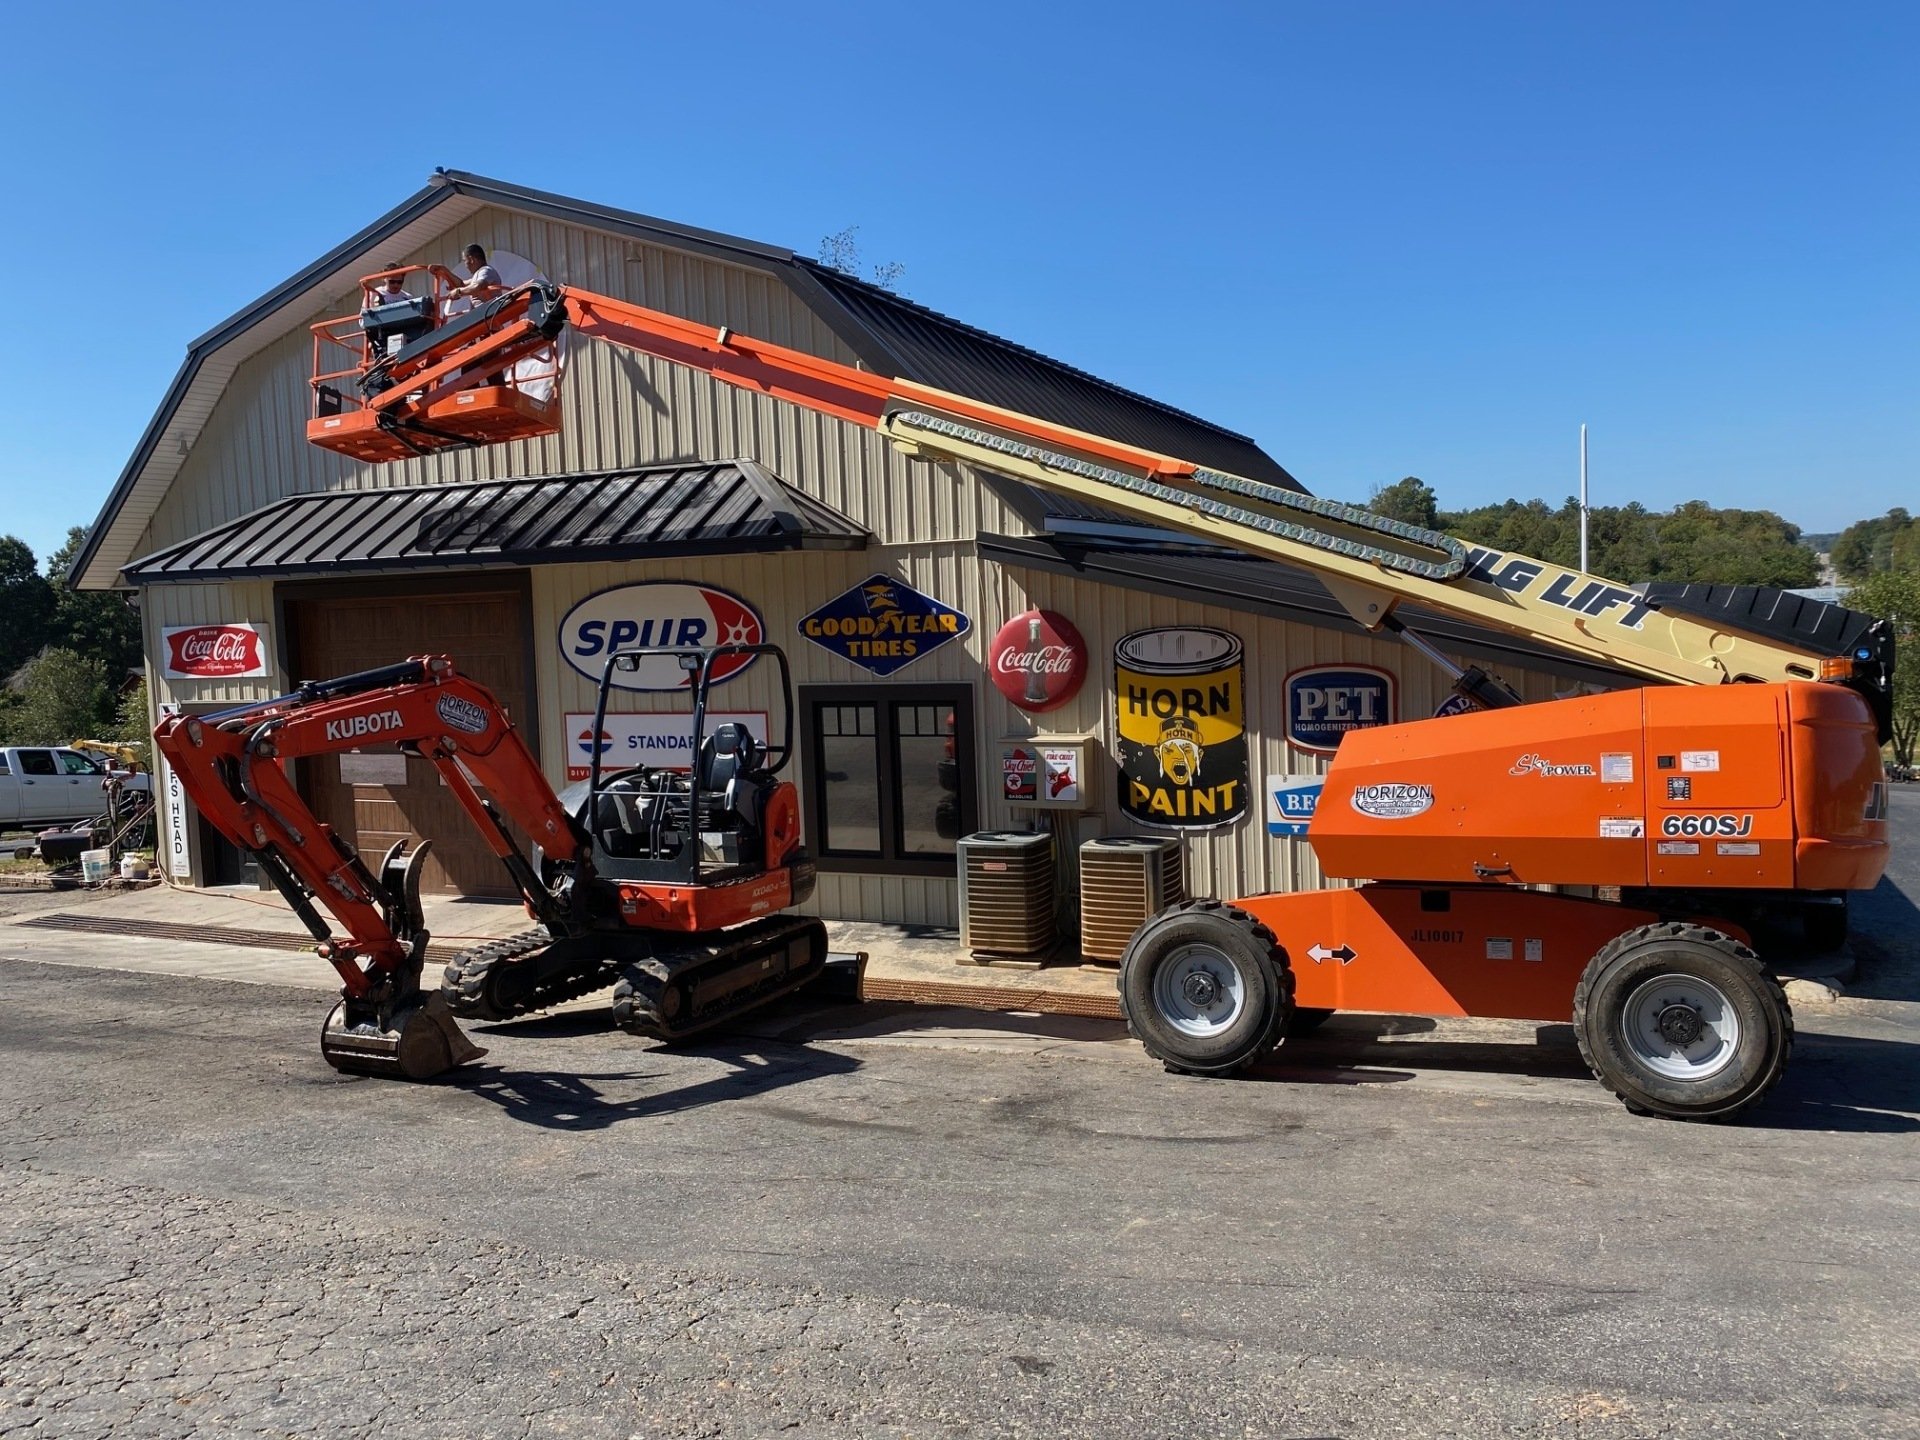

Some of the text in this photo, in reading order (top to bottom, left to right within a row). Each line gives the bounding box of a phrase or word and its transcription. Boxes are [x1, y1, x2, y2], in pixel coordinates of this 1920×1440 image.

[1538, 572, 1660, 628] LIFT
[182, 632, 247, 662] Coca-Cola
[574, 618, 708, 656] SPUR
[846, 639, 918, 657] TIRES
[997, 646, 1075, 673] Coca-Cola
[439, 691, 488, 722] HORIZON
[1128, 681, 1230, 719] HORN
[1297, 687, 1381, 721] PET
[326, 710, 404, 741] KUBOTA
[1166, 730, 1193, 741] HORN
[628, 735, 706, 749] STANDA
[1129, 779, 1238, 817] PAINT
[1355, 785, 1432, 801] HORIZON
[171, 803, 183, 854] HEAD
[1661, 814, 1753, 838] 660SJ
